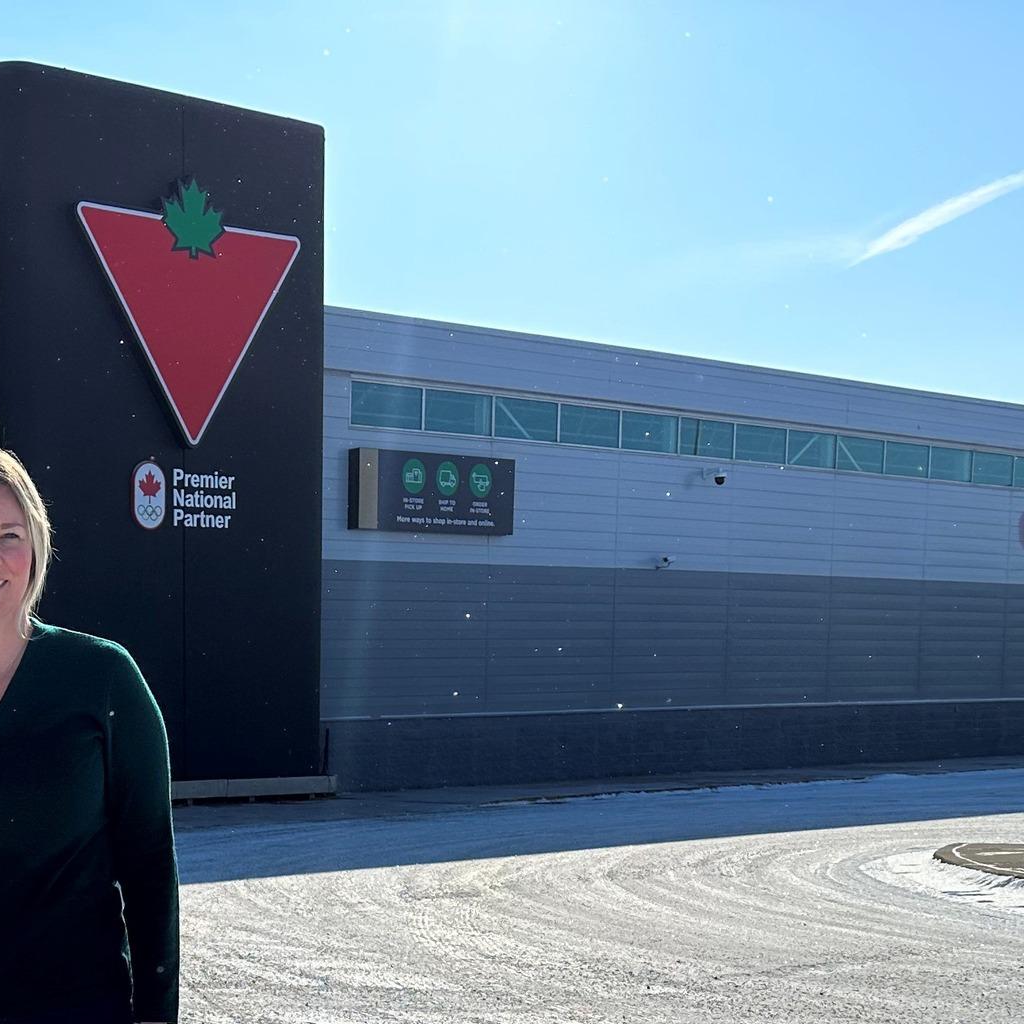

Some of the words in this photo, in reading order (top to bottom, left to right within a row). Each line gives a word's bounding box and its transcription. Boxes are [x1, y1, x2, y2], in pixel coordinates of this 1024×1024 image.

[172, 468, 236, 490] Premier
[172, 488, 237, 510] National
[172, 508, 232, 529] Partner
[396, 515, 411, 523] More
[411, 517, 425, 525] ways
[433, 517, 446, 526] shop
[446, 518, 467, 526] in-store
